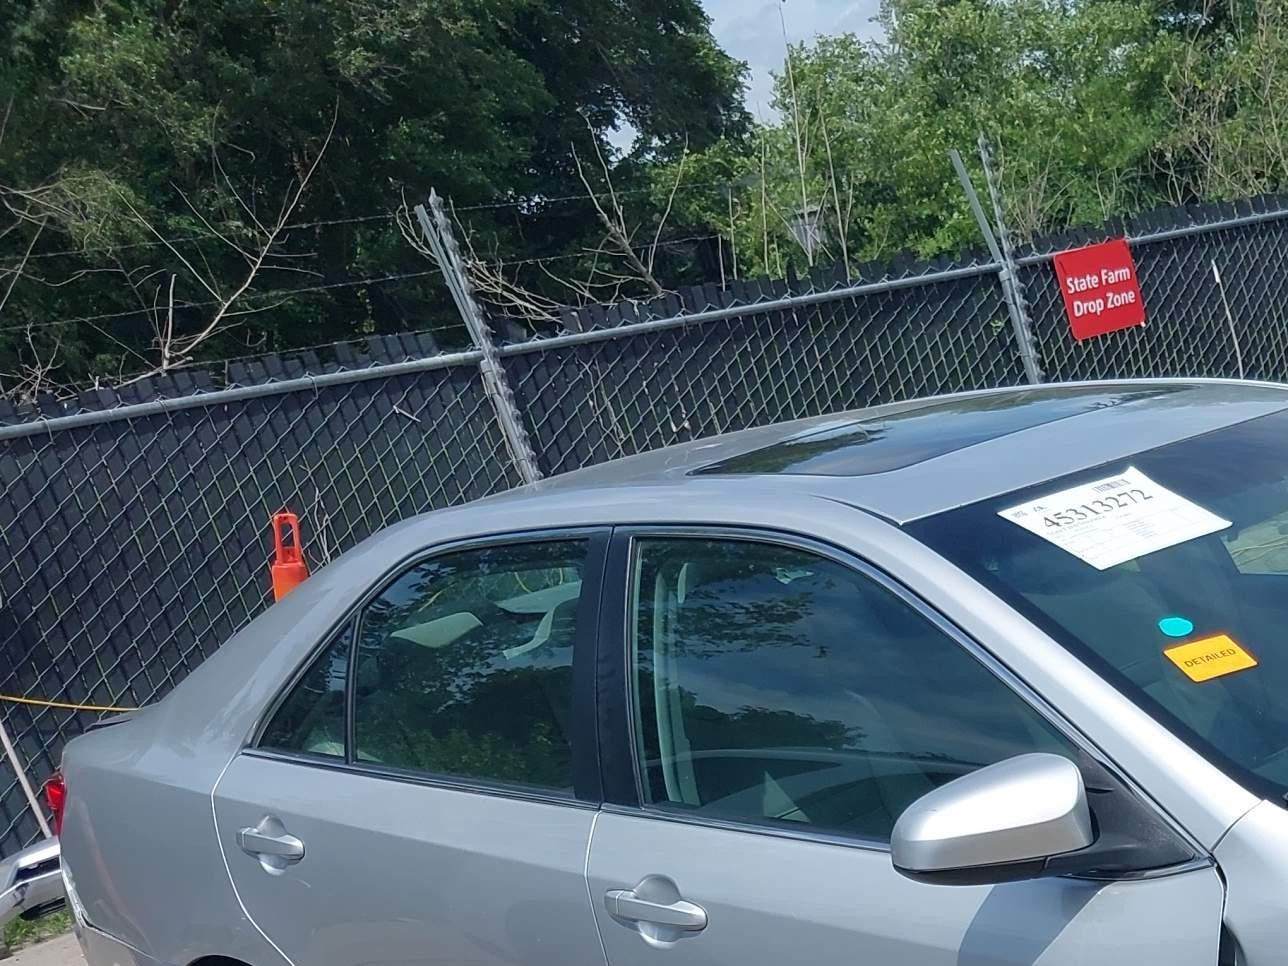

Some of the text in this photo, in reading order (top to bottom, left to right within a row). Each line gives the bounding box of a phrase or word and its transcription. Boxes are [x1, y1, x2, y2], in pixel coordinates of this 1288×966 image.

[1066, 268, 1131, 294] State Farm
[1073, 290, 1136, 317] Drop Zone
[1043, 488, 1153, 529] 45313272
[1183, 648, 1237, 668] DETAILED
